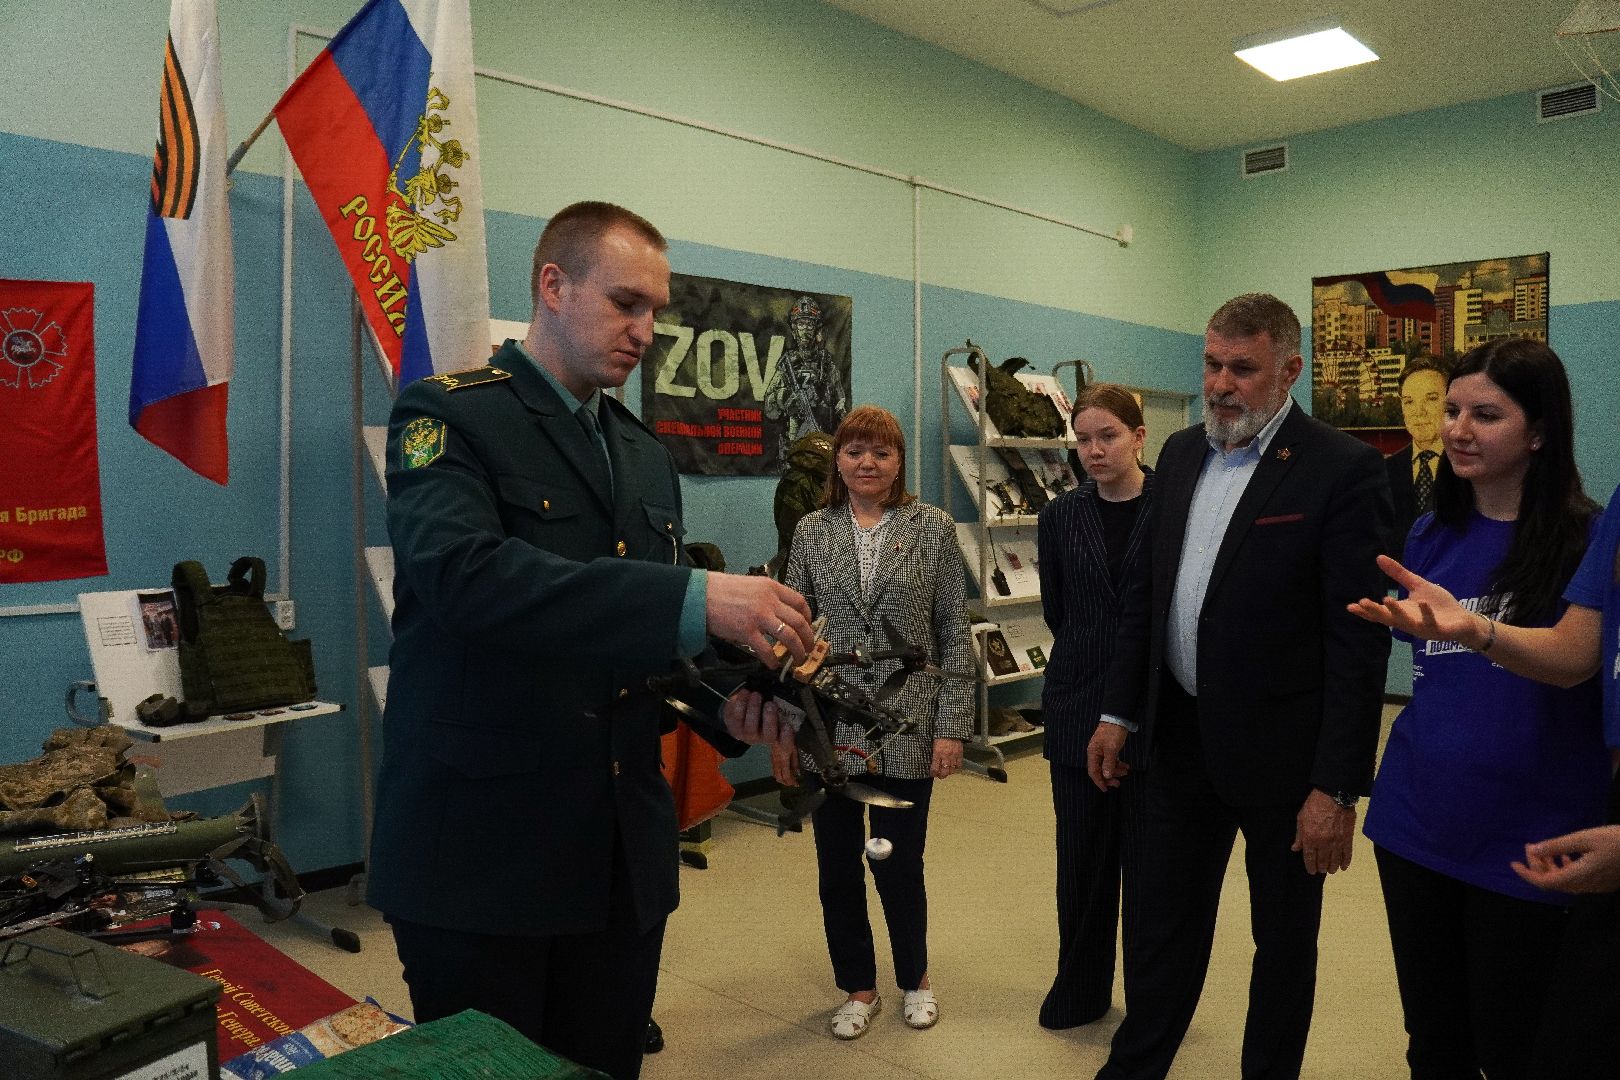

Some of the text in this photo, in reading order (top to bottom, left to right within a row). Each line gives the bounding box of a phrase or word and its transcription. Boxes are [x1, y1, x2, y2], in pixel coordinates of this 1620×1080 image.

[653, 321, 786, 402] ZOV
[717, 408, 763, 422] УЧАСТНИК
[723, 425, 763, 440] ВОЕННОЙ
[15, 505, 87, 525] Бригада
[217, 1006, 261, 1047] Генера
